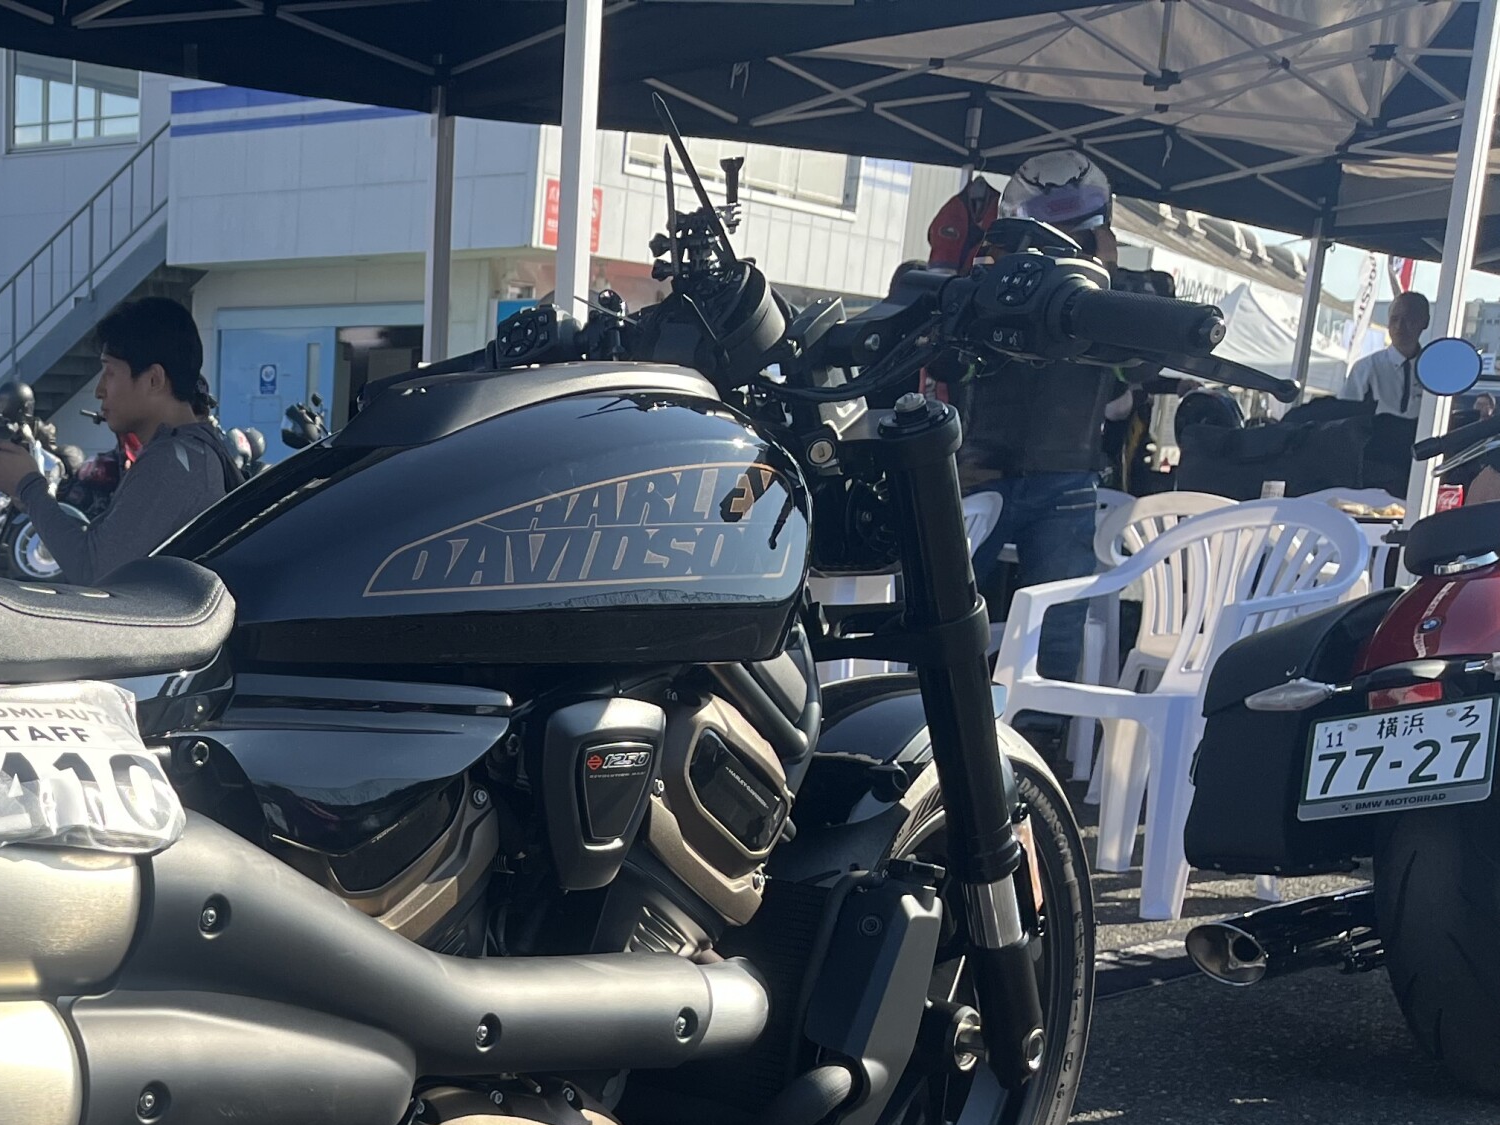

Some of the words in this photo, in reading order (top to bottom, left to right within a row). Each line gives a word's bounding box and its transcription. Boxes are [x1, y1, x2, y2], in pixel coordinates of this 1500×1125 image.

[398, 524, 790, 588] DAVIDSO
[1376, 712, 1425, 739] 横浜
[1458, 704, 1481, 728] ろ
[1325, 731, 1344, 748] 11
[602, 751, 651, 769] 1250
[1317, 732, 1482, 796] 77-27
[1355, 800, 1382, 811] BMW
[1384, 792, 1446, 808] MOTORRAD
